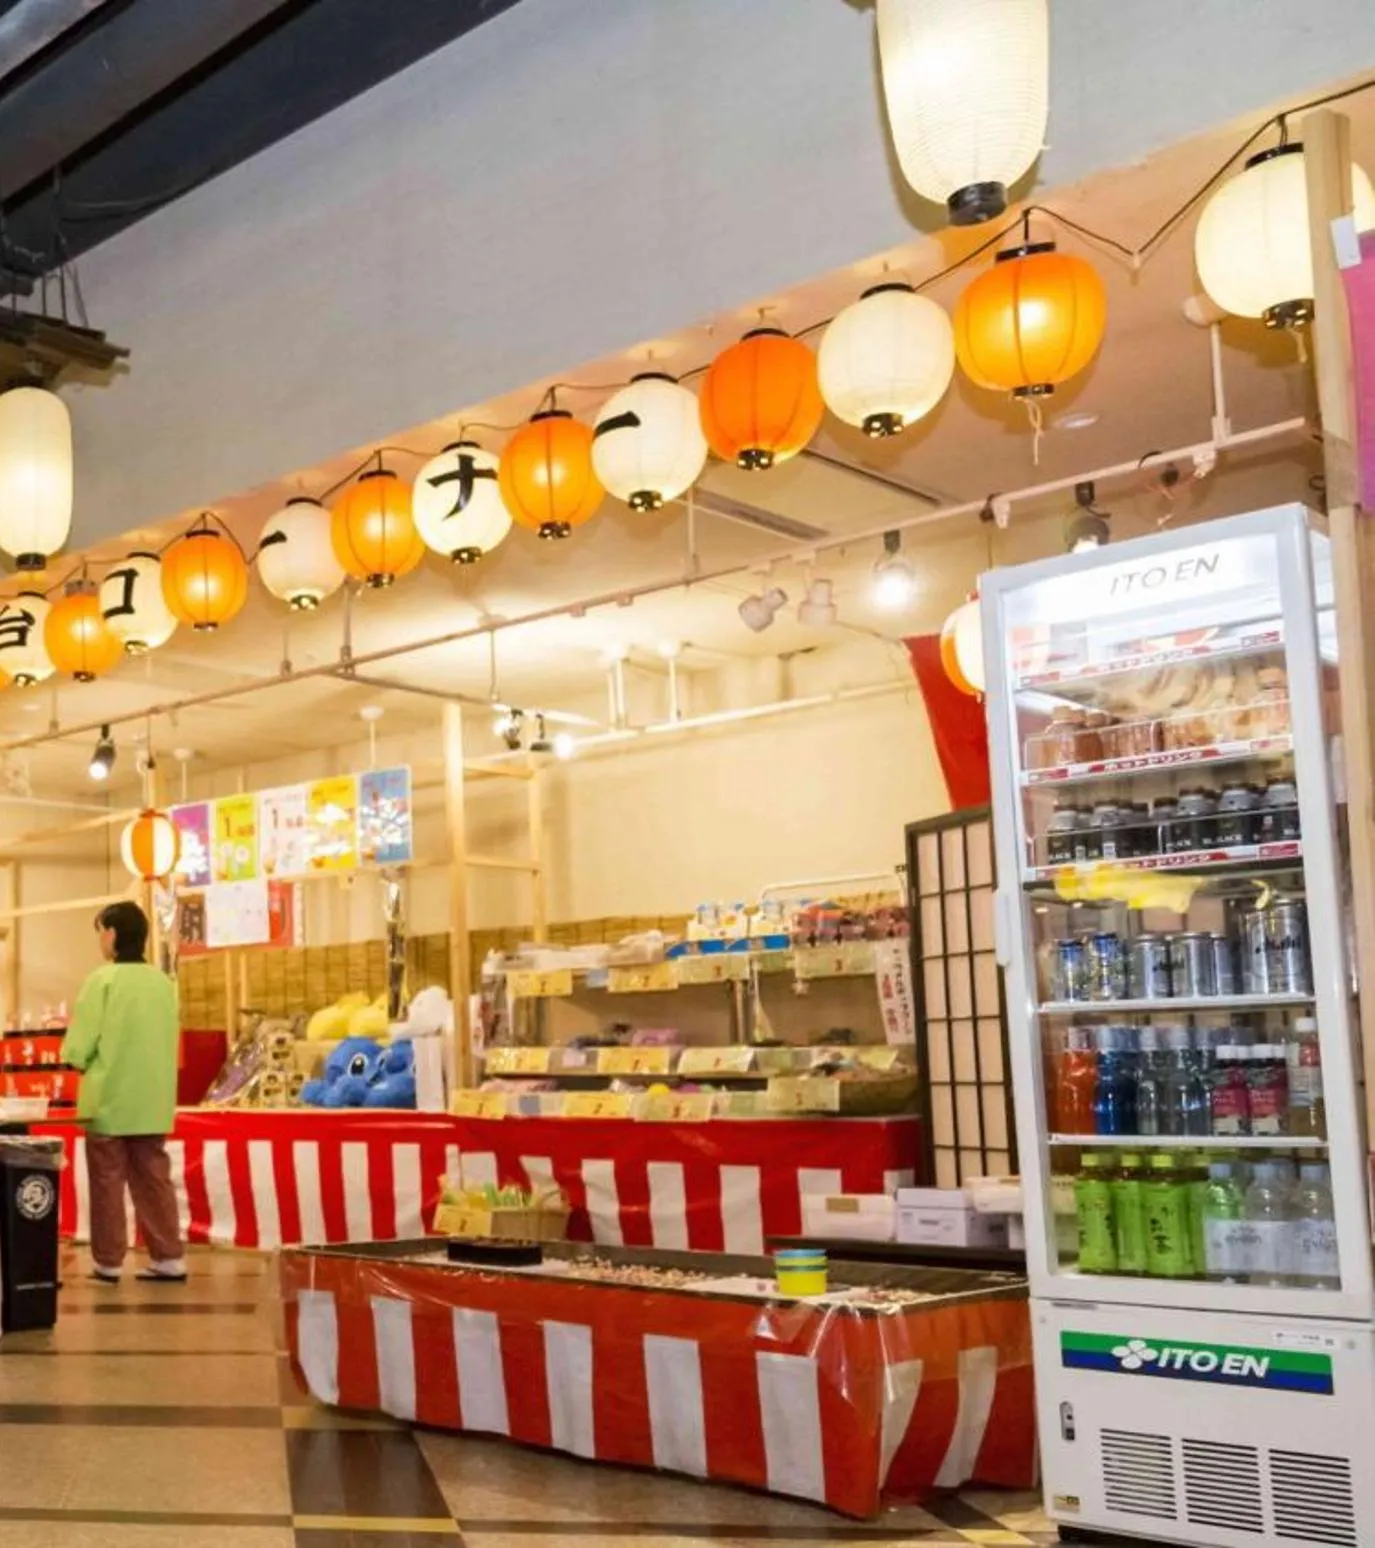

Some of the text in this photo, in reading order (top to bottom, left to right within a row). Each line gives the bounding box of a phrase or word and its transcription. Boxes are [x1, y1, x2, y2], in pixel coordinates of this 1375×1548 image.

[426, 454, 498, 521] ナ
[1110, 553, 1219, 596] ITO EN
[1158, 1347, 1270, 1379] ITO EN
